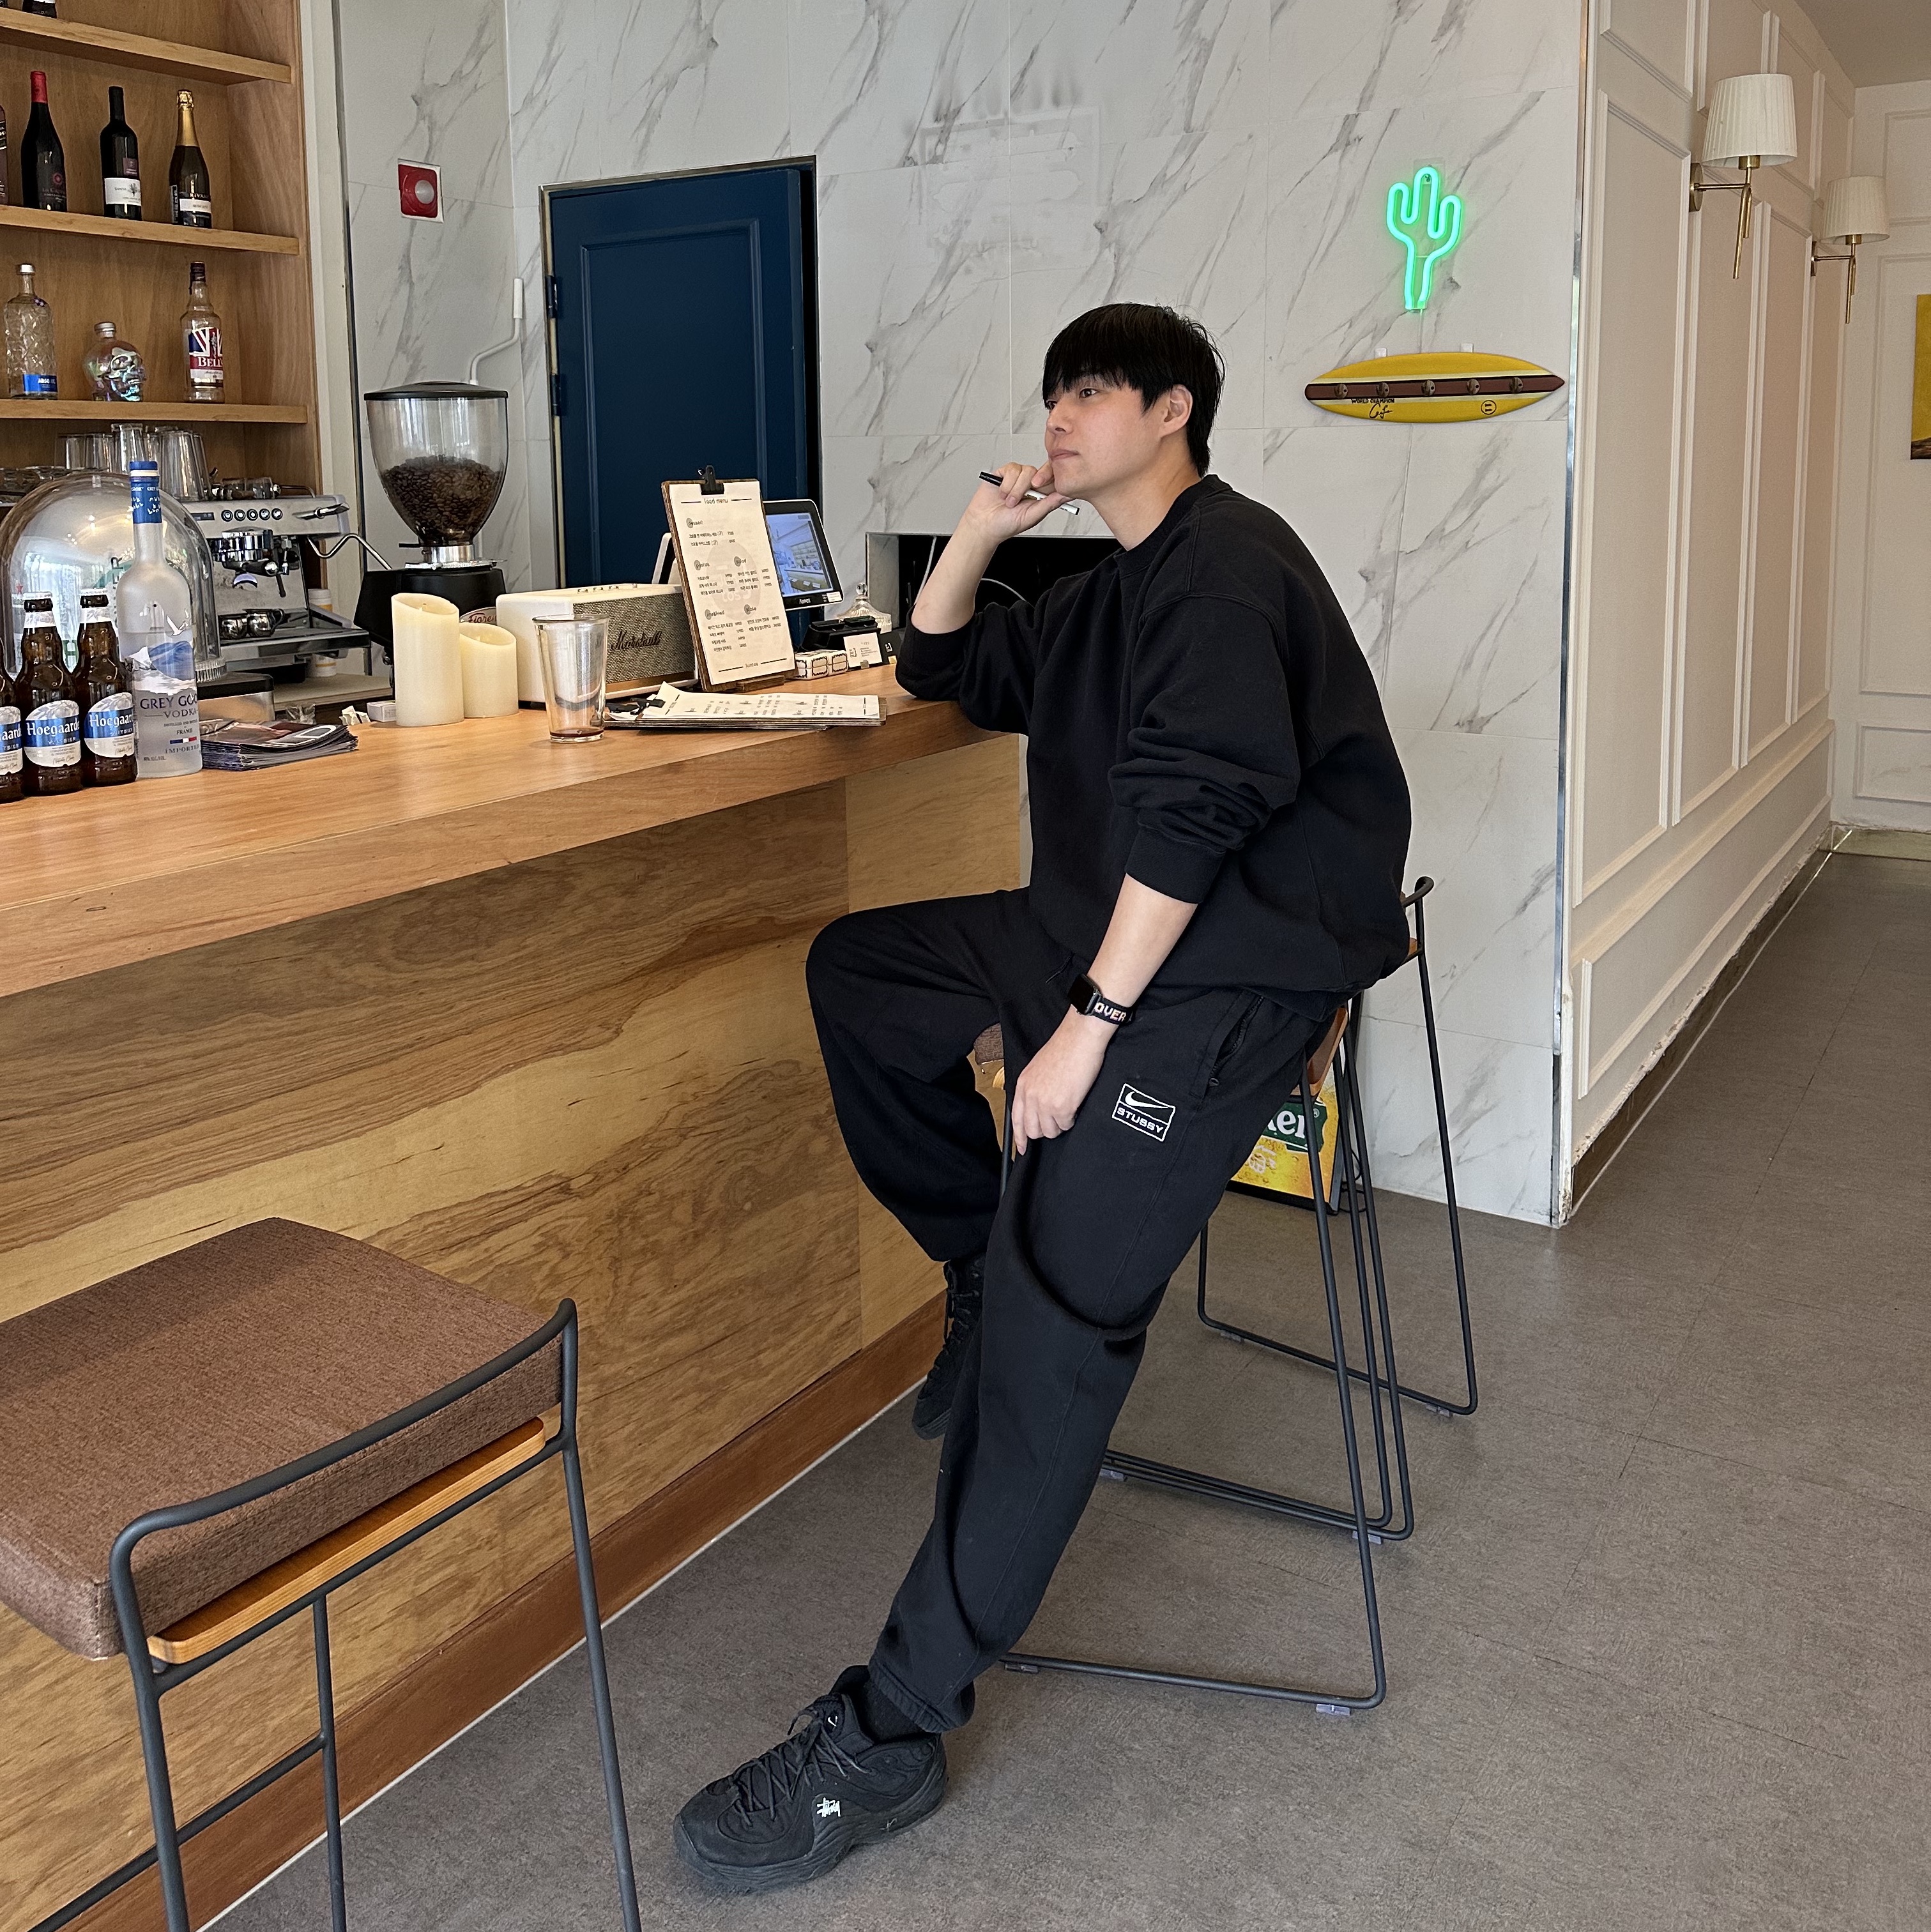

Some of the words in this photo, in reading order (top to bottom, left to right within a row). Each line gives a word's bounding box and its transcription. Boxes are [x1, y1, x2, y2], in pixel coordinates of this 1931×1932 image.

[611, 630, 663, 651] Marshall
[140, 697, 174, 709] GREY
[1094, 1001, 1127, 1022] OVER
[1117, 1107, 1164, 1134] STUSSY
